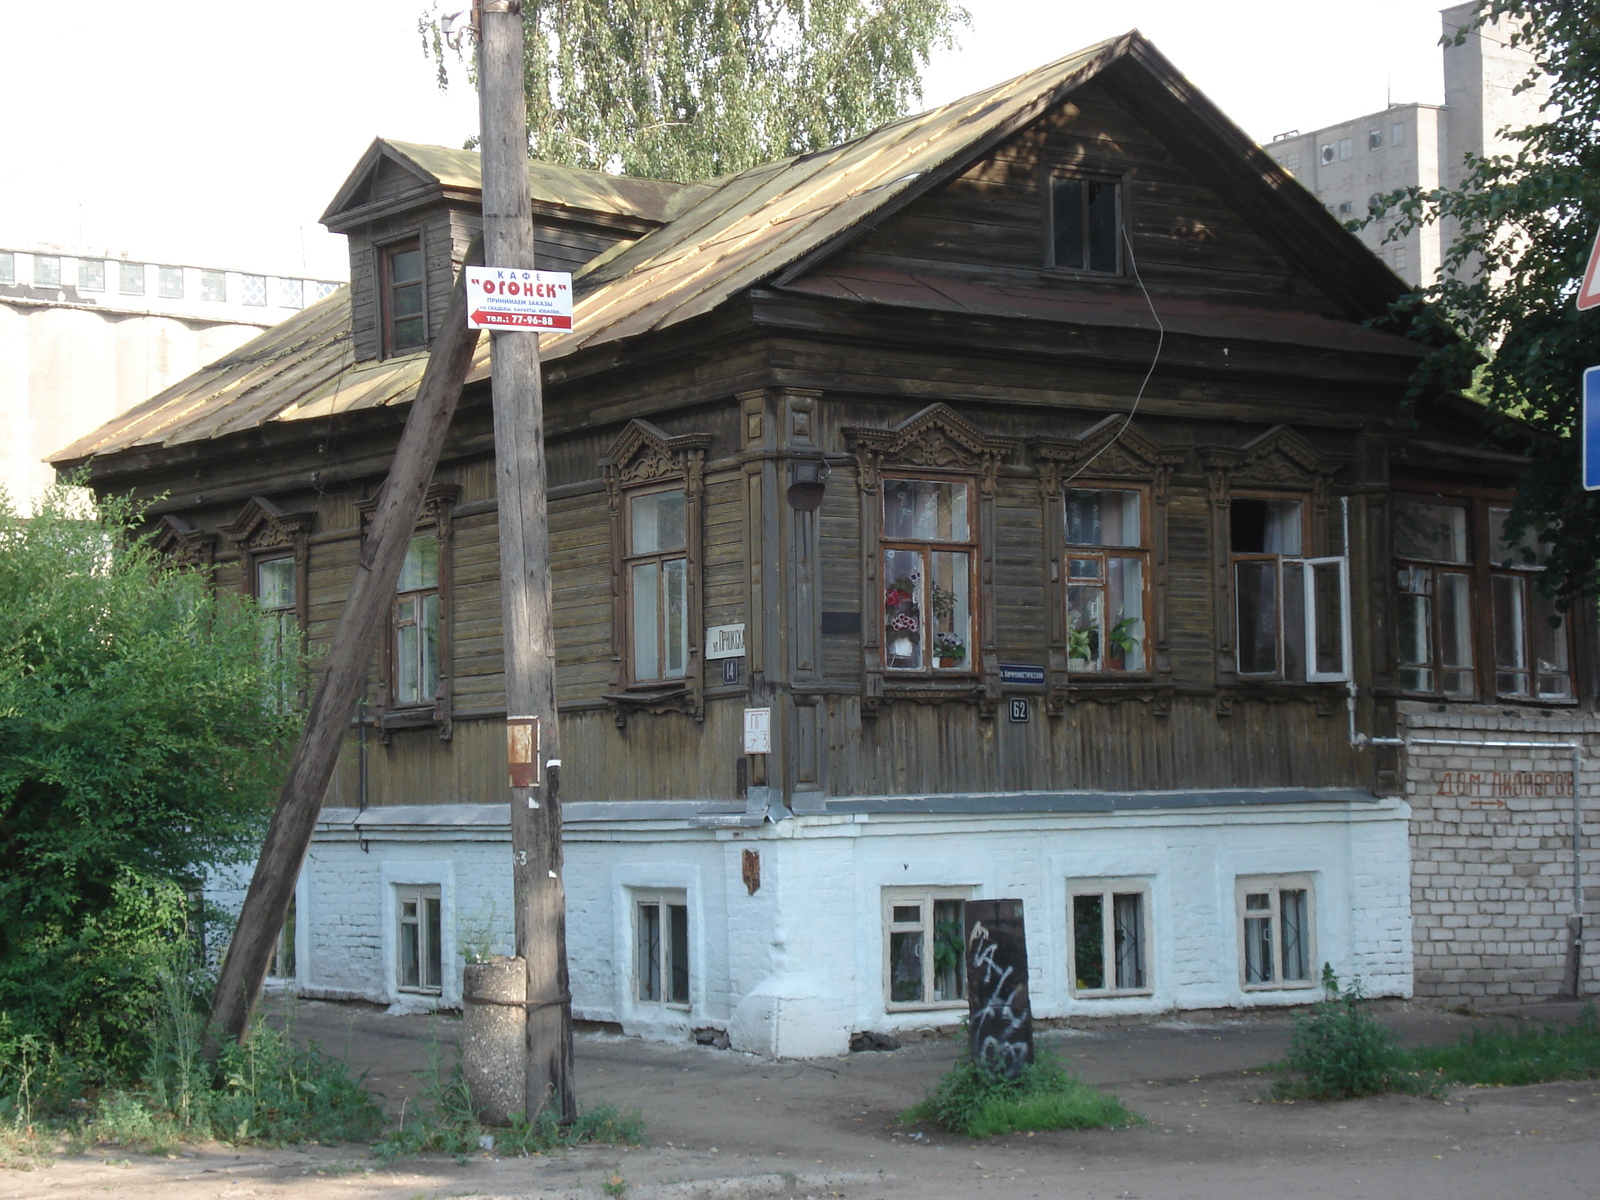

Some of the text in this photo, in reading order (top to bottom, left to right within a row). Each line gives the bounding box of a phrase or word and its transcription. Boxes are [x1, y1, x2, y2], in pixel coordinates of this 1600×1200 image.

[497, 271, 541, 281] КАФЕ
[487, 297, 553, 307] ПРИНИМАЕМ ЗАКАЗЫ
[486, 315, 553, 325] тел.: 77-96-88
[726, 662, 734, 680] 14
[1013, 701, 1025, 718] 62
[750, 713, 763, 729] ПГ
[1436, 771, 1481, 796] ДОМ
